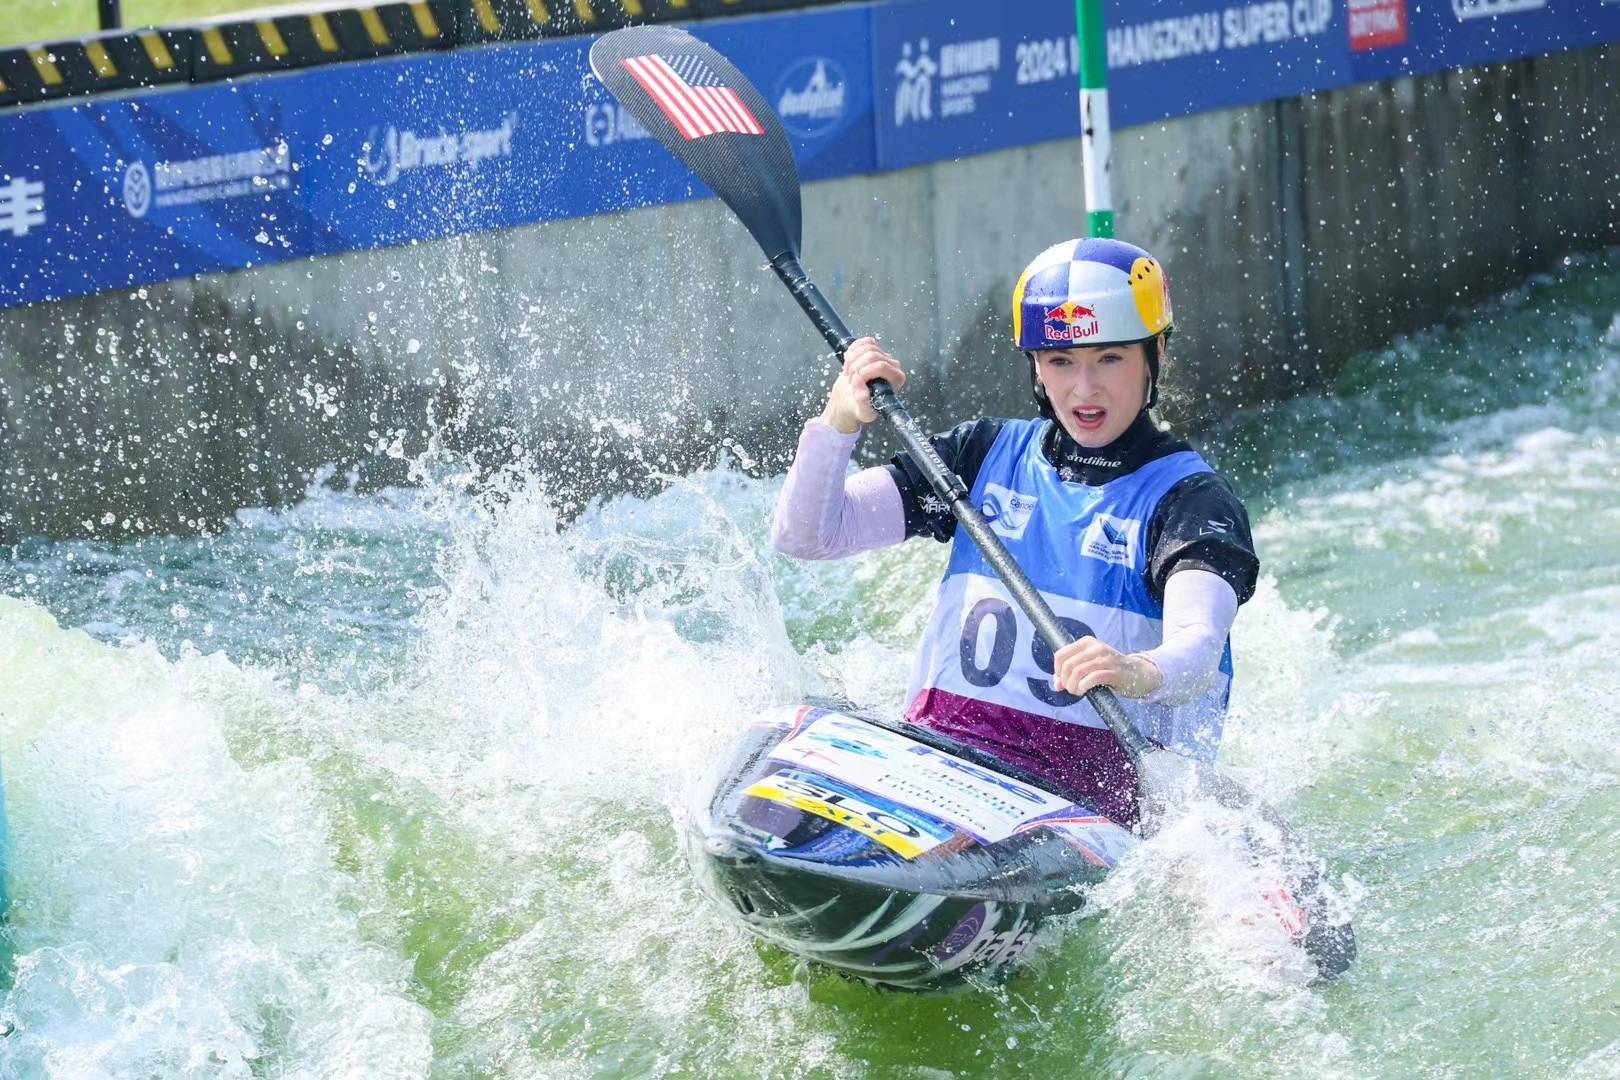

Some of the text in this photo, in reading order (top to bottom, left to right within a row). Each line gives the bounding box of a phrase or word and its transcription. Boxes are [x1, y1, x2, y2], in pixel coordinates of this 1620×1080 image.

[1016, 39, 1067, 85] 2024
[1107, 12, 1220, 69] HANGZHOU
[1223, 2, 1291, 49] SUPER
[1292, 0, 1333, 37] CUP
[1045, 320, 1099, 340] Red Bull
[1065, 453, 1122, 468] andiline
[960, 597, 1098, 708] 09
[775, 779, 921, 839] SLO
